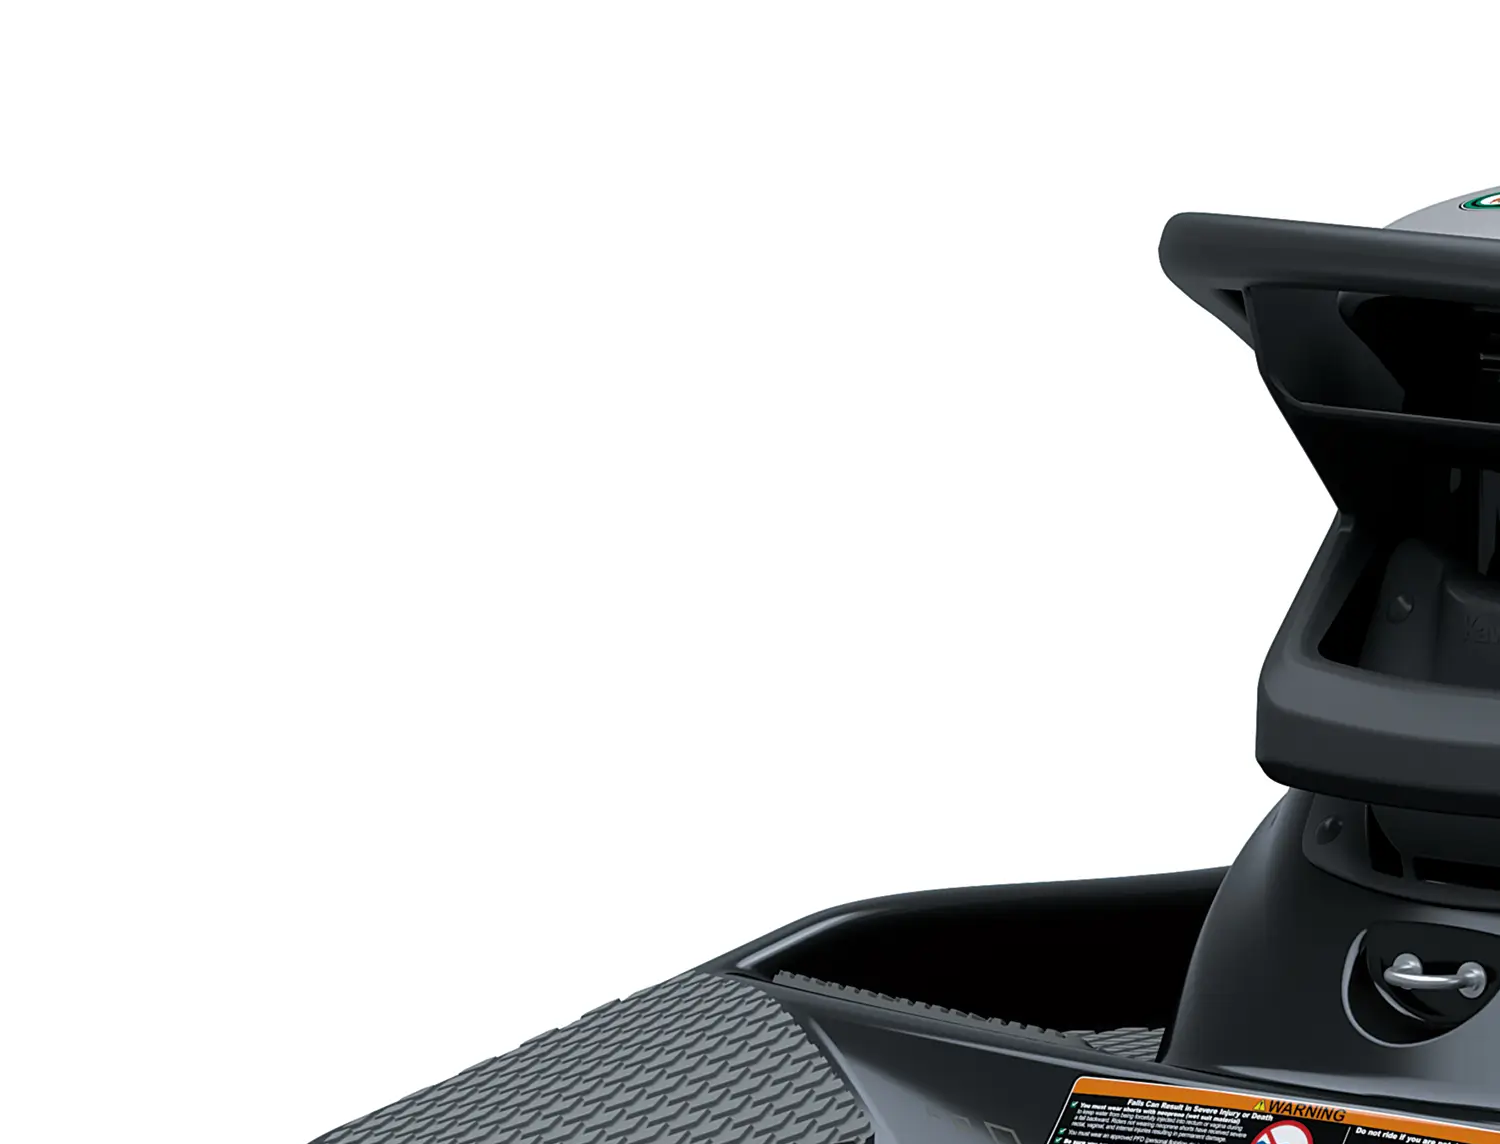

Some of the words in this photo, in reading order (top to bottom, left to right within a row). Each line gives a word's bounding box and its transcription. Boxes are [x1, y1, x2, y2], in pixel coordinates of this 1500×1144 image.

[1127, 1098, 1144, 1107] Falls
[1160, 1102, 1184, 1111] Result
[1193, 1105, 1218, 1114] Severe
[1219, 1108, 1241, 1118] Injury
[1251, 1112, 1274, 1122] Death
[1268, 1100, 1346, 1122] WARNING
[1382, 1132, 1398, 1140] ride
